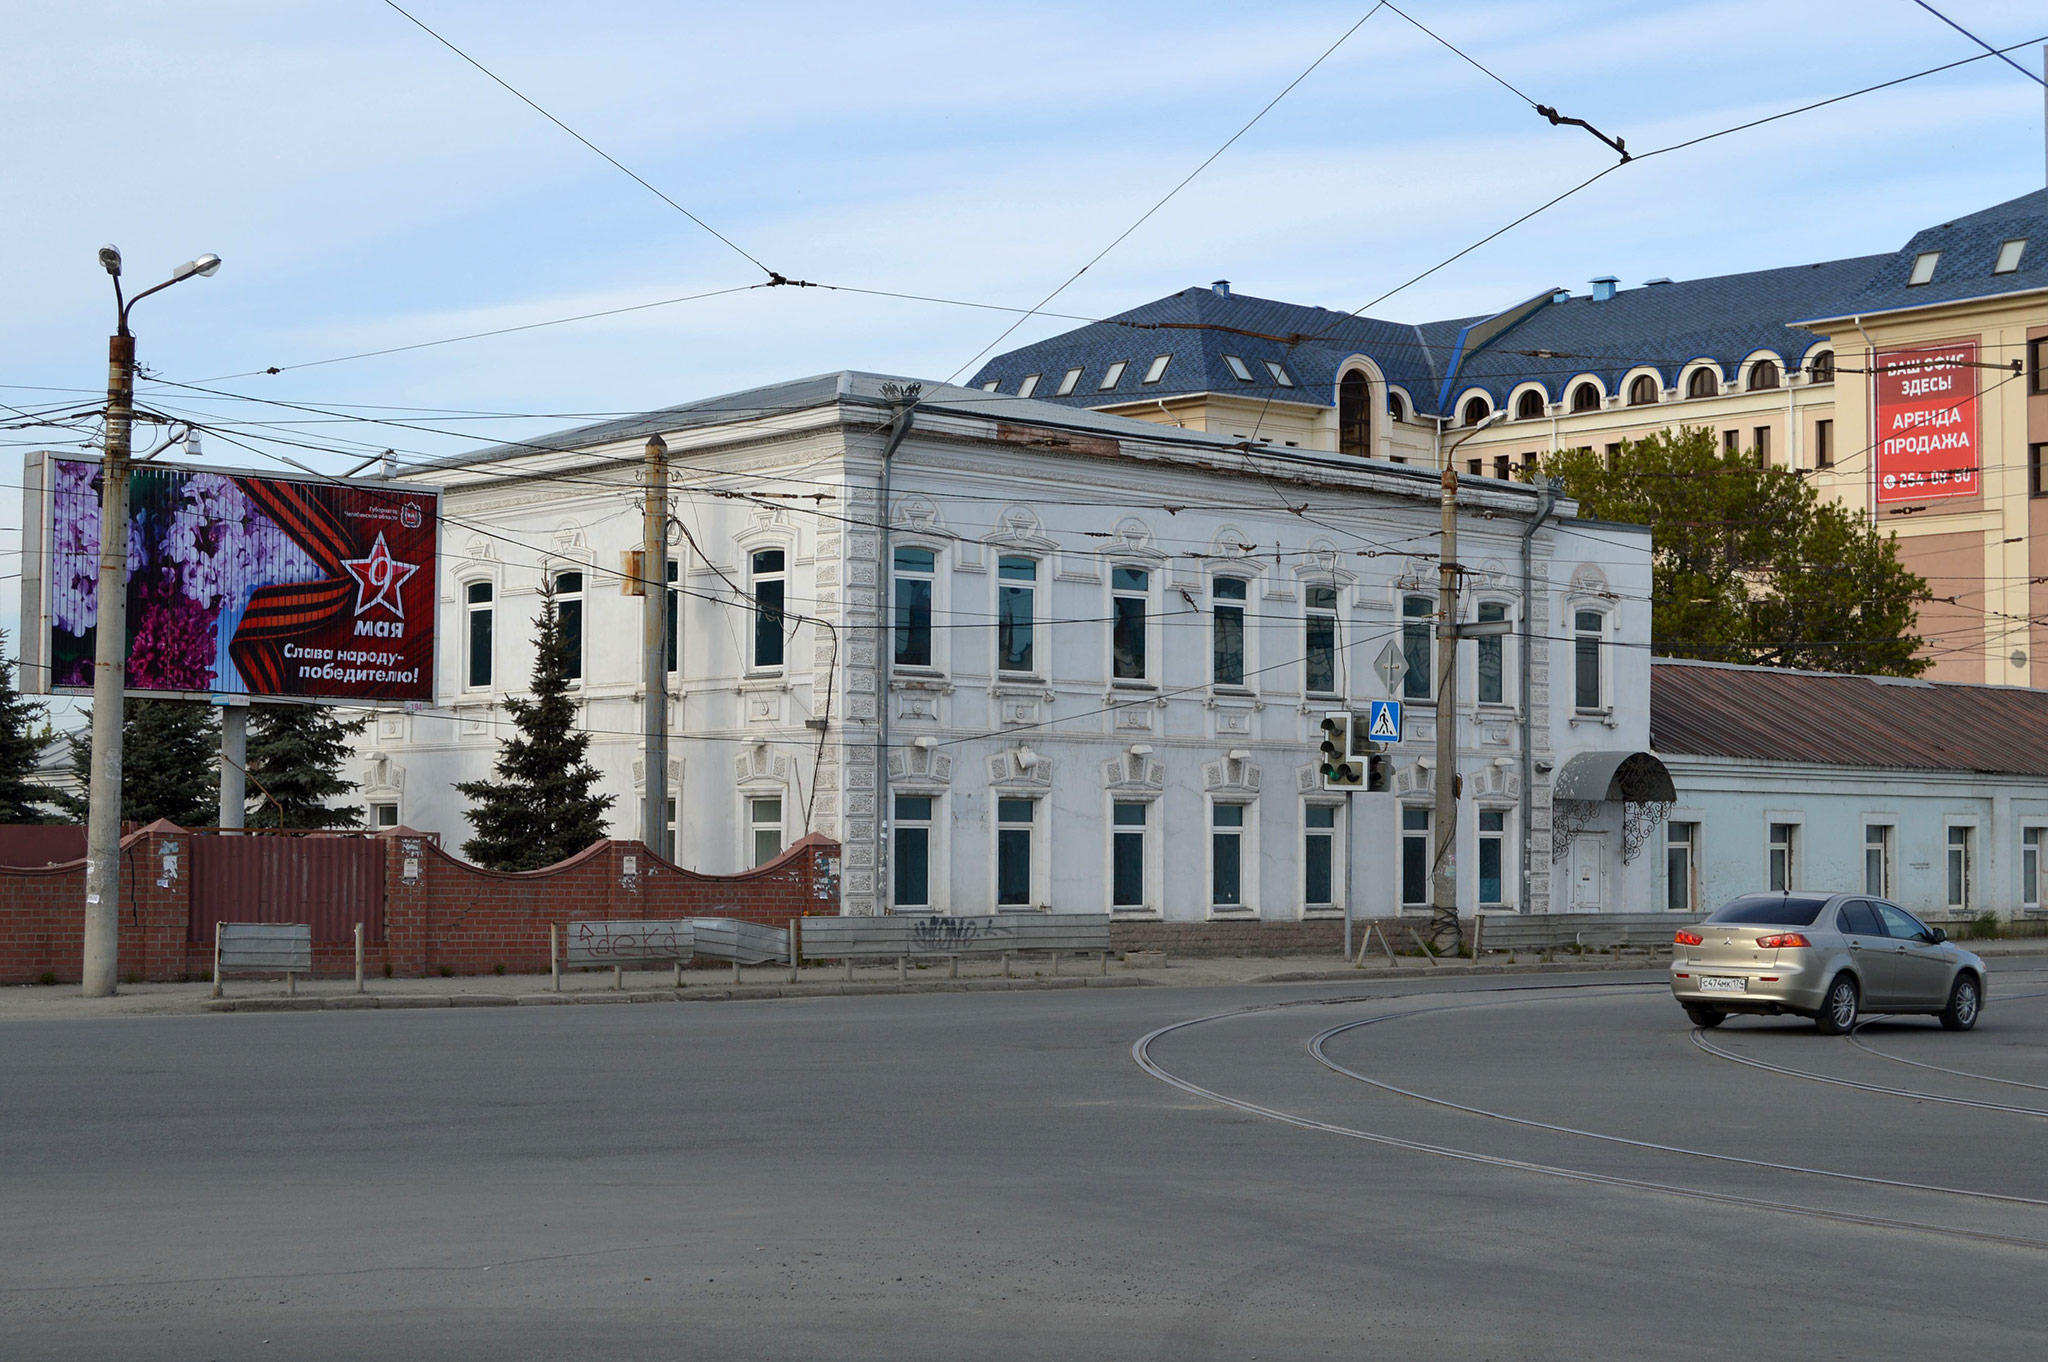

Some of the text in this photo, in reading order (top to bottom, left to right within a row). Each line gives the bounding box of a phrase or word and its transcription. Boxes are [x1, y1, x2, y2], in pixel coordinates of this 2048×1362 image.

[1901, 375, 1952, 397] ЗДЕСЬ!
[1892, 407, 1961, 430] АРЕНДА
[1884, 432, 1970, 455] ПРОДАЖА
[368, 556, 393, 600] 9
[283, 643, 333, 660] Слава
[299, 663, 419, 684] победителю!
